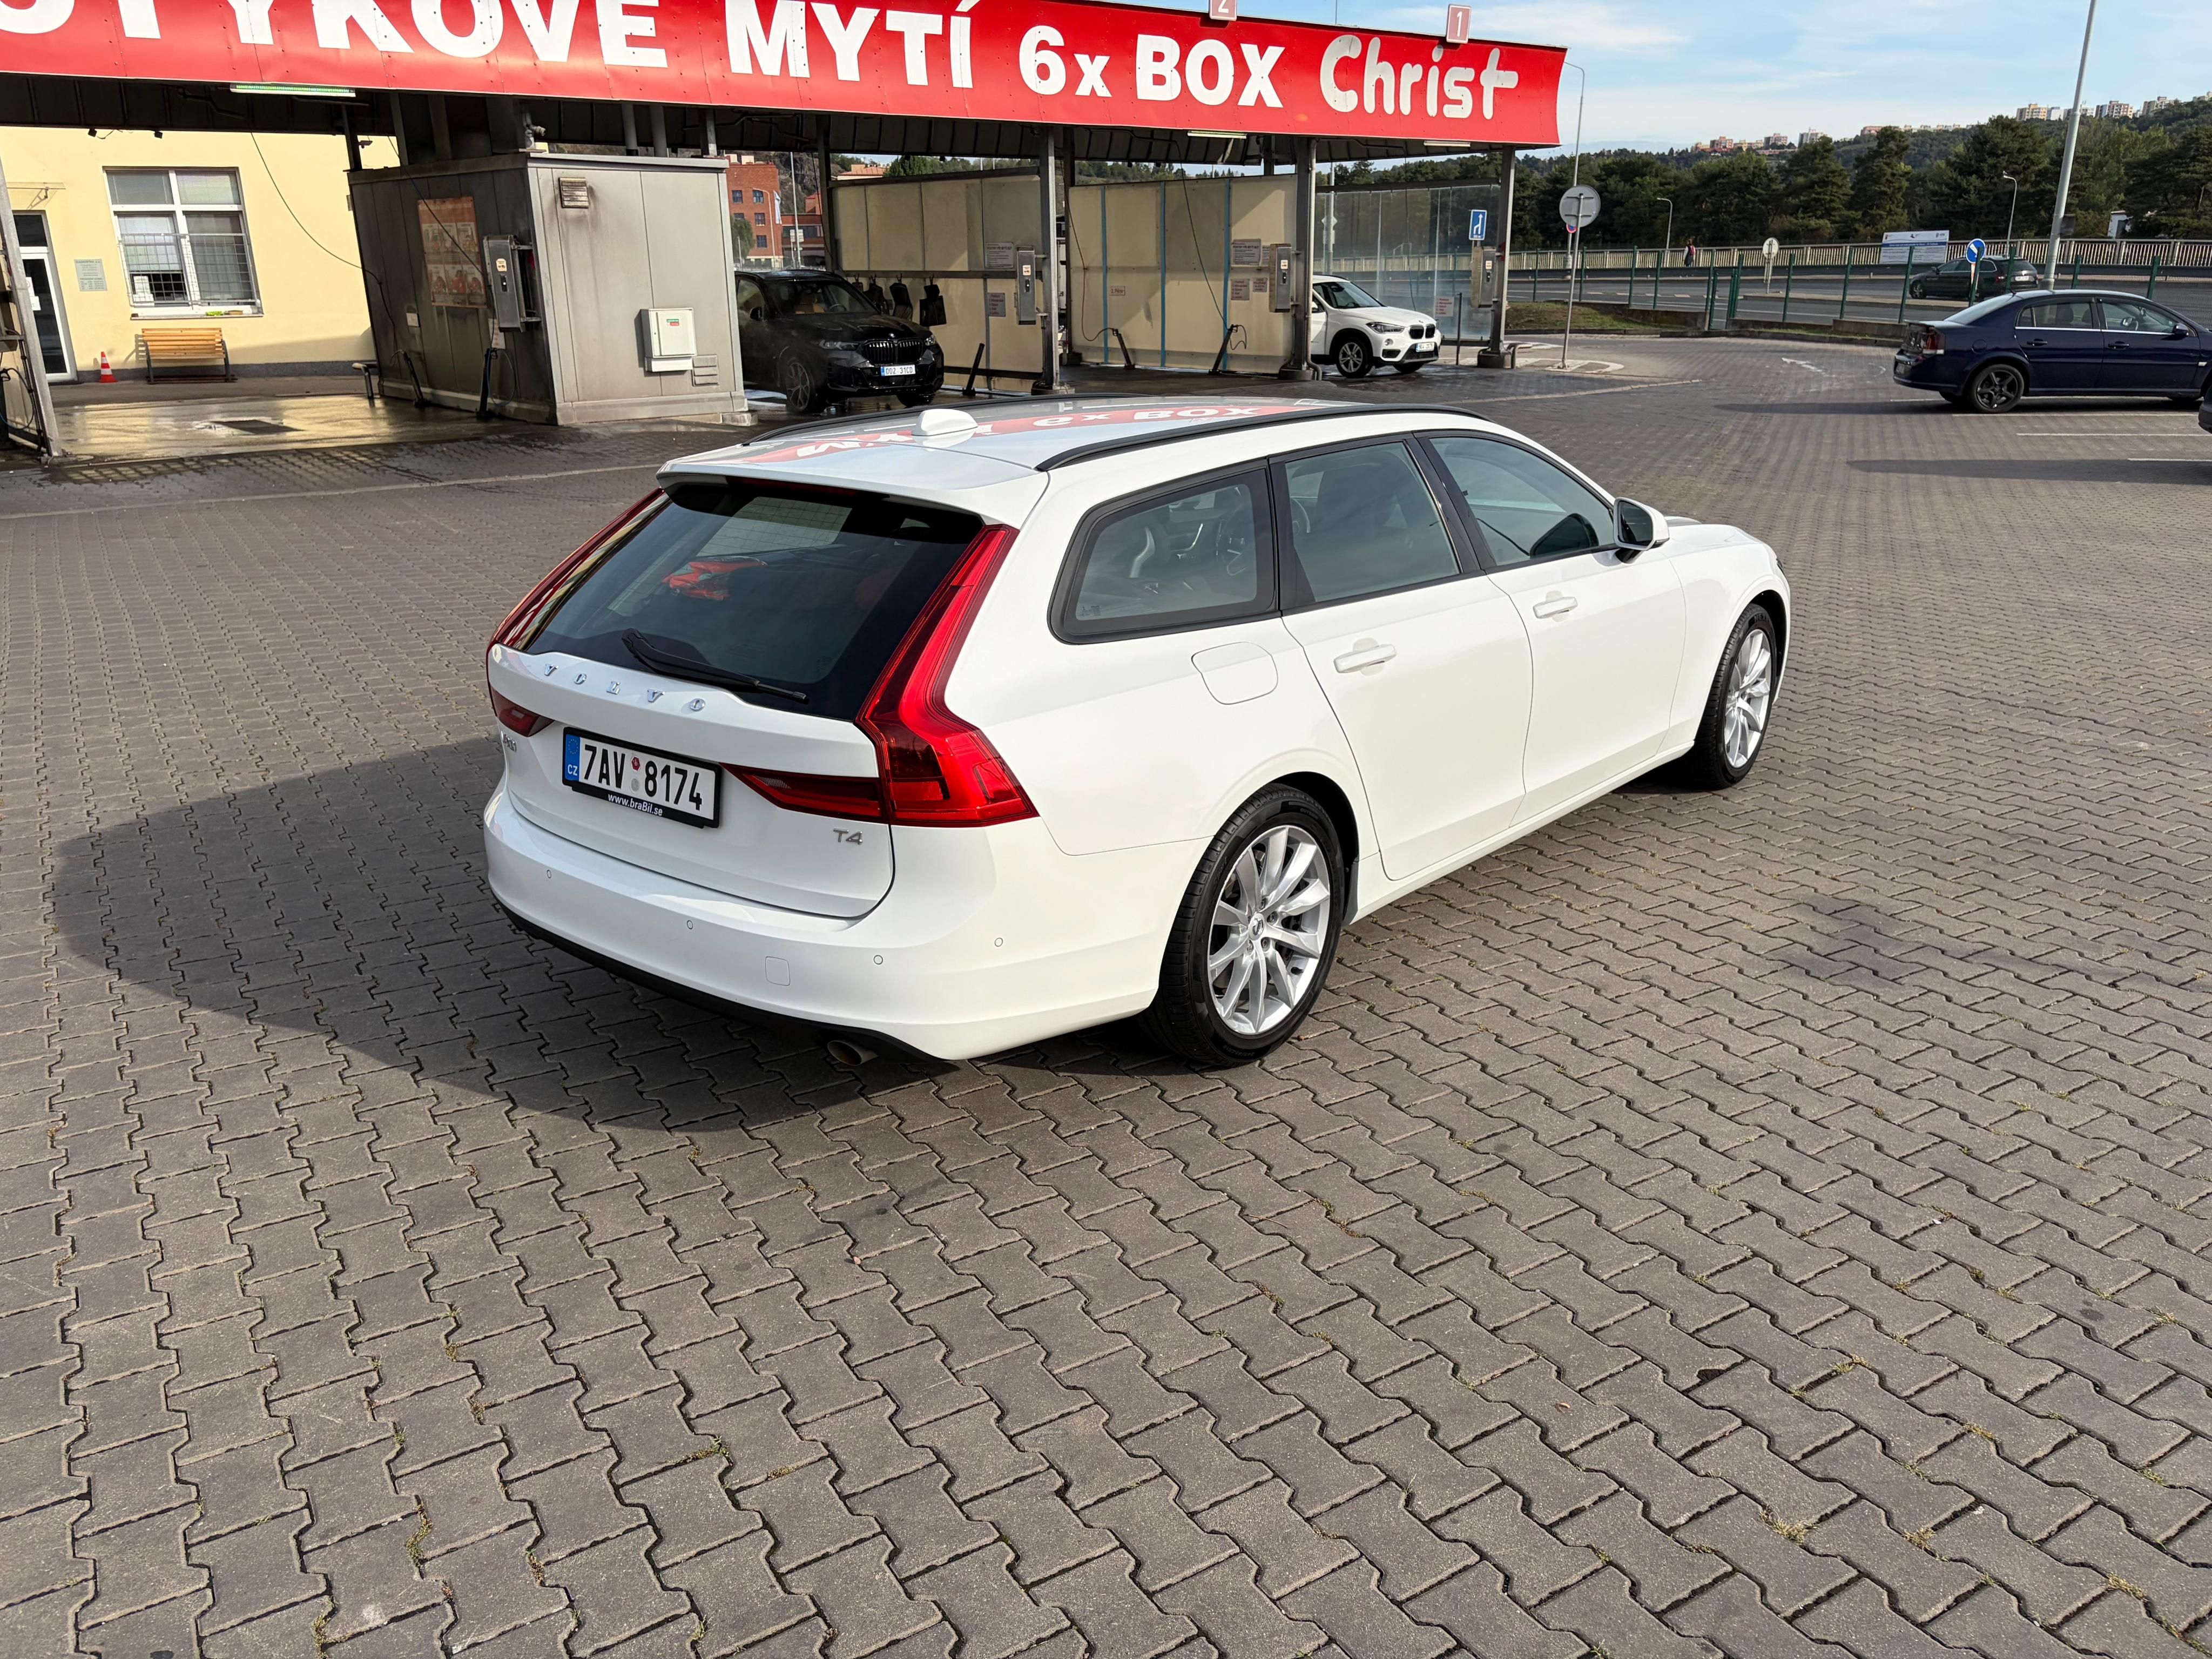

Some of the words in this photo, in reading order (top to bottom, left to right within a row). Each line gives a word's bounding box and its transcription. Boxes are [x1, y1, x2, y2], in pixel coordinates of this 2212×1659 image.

[1456, 11, 1462, 37] 1
[725, 0, 980, 89] MYTÍ
[1136, 34, 1285, 108] BOX
[1320, 35, 1519, 119] Christ
[544, 664, 706, 712] VOLVO
[568, 764, 578, 776] CZ
[584, 744, 625, 789] 7AV
[645, 760, 703, 811] 8174
[608, 793, 663, 817] www.braBil.se
[833, 828, 863, 845] T4
